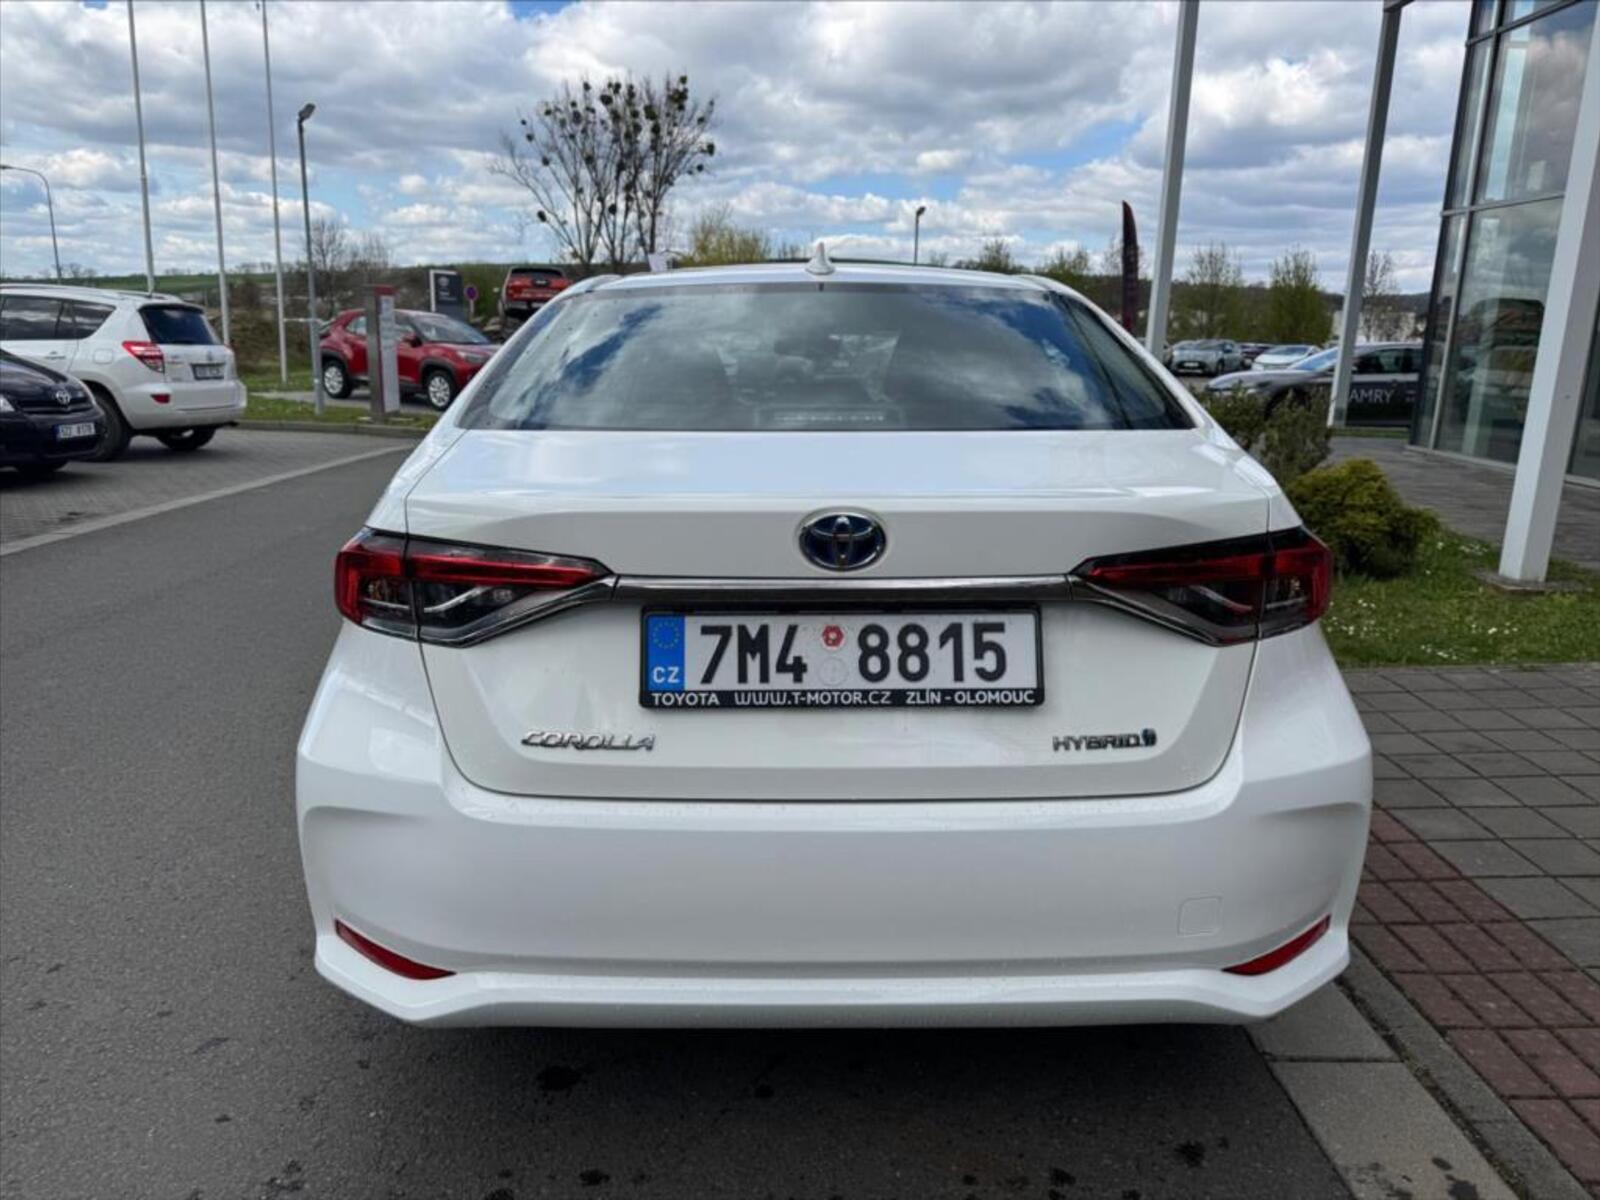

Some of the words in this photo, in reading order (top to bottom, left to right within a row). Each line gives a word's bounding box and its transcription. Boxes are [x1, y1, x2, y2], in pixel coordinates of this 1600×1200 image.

[1350, 388, 1395, 404] AMRY
[700, 624, 808, 684] 7M4
[858, 622, 1007, 683] 8815
[652, 666, 681, 685] CZ
[652, 693, 720, 706] TOYOTA
[734, 691, 892, 705] WWW.T-MOTOR.CZ
[906, 688, 940, 704] ZLÍN
[954, 689, 1035, 705] OLOMOUC
[521, 731, 656, 751] COROLLA
[1052, 734, 1140, 752] HYBRID
